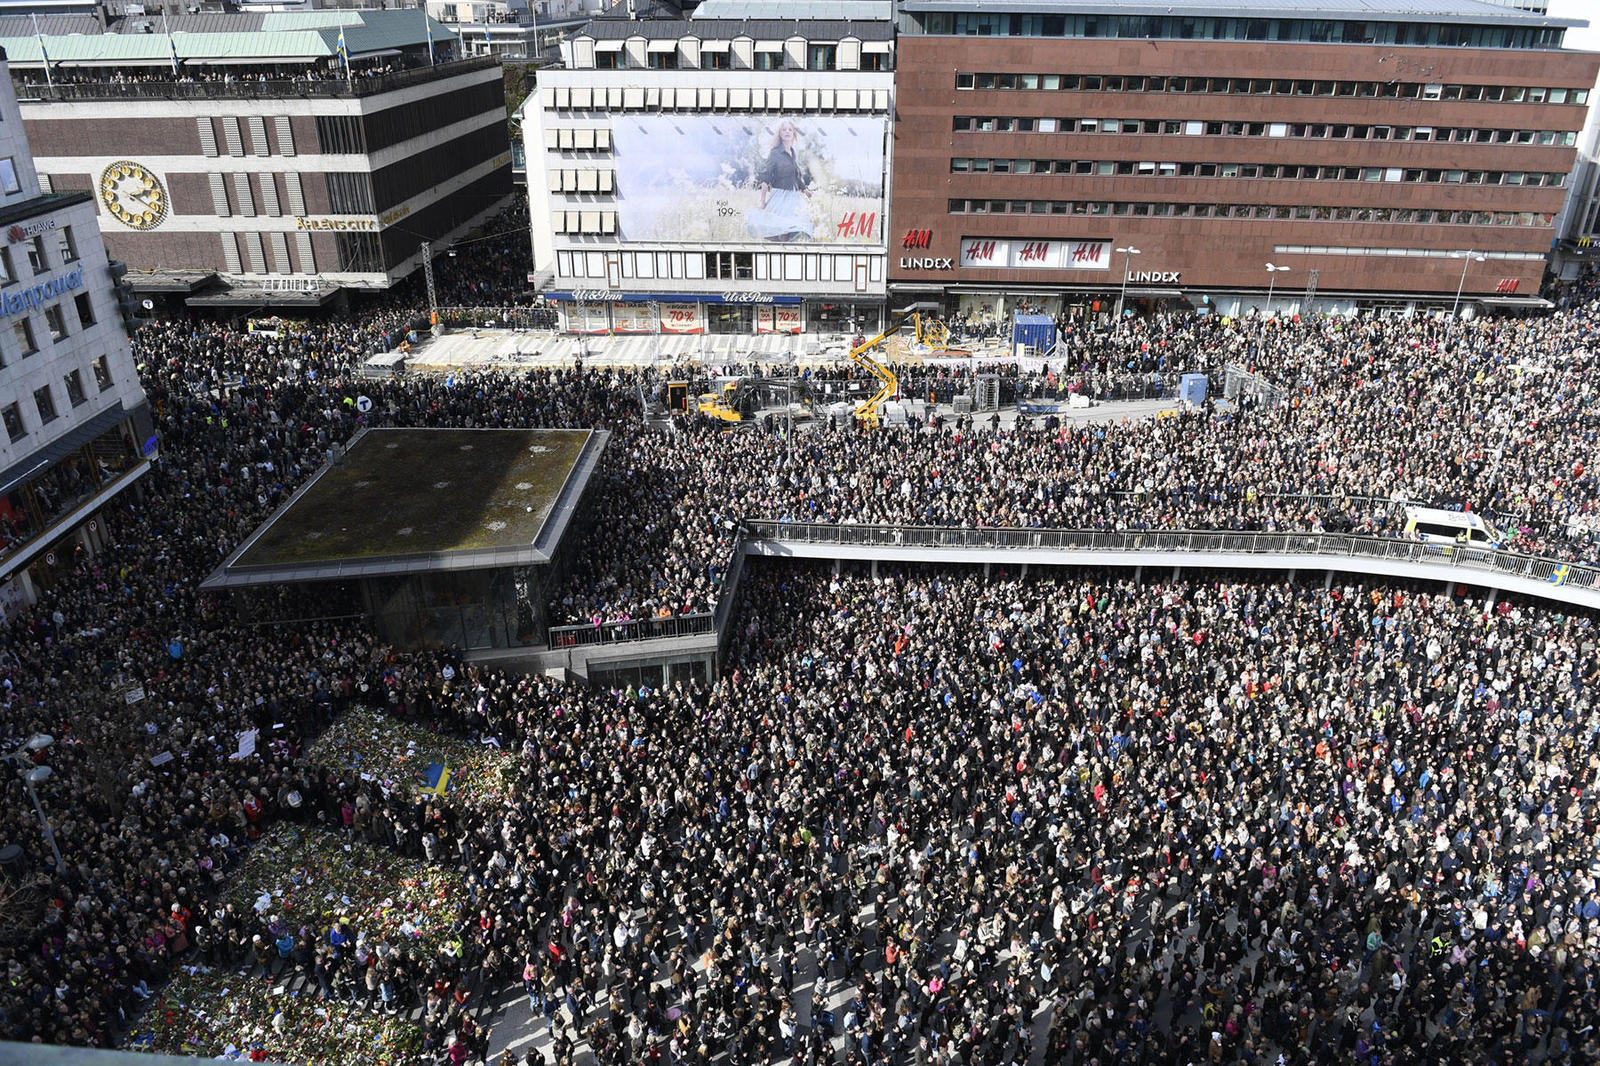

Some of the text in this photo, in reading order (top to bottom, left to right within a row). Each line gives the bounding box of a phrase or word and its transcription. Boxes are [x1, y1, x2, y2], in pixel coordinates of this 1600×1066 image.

[837, 211, 875, 239] H&M
[902, 229, 931, 248] H&M
[966, 241, 996, 261] H&M
[1020, 242, 1049, 262] H&M
[1072, 243, 1102, 263] H&M
[900, 257, 952, 269] LINDEX
[1128, 271, 1180, 283] LINDEX
[669, 310, 695, 322] 70%
[778, 312, 799, 322] 70%
